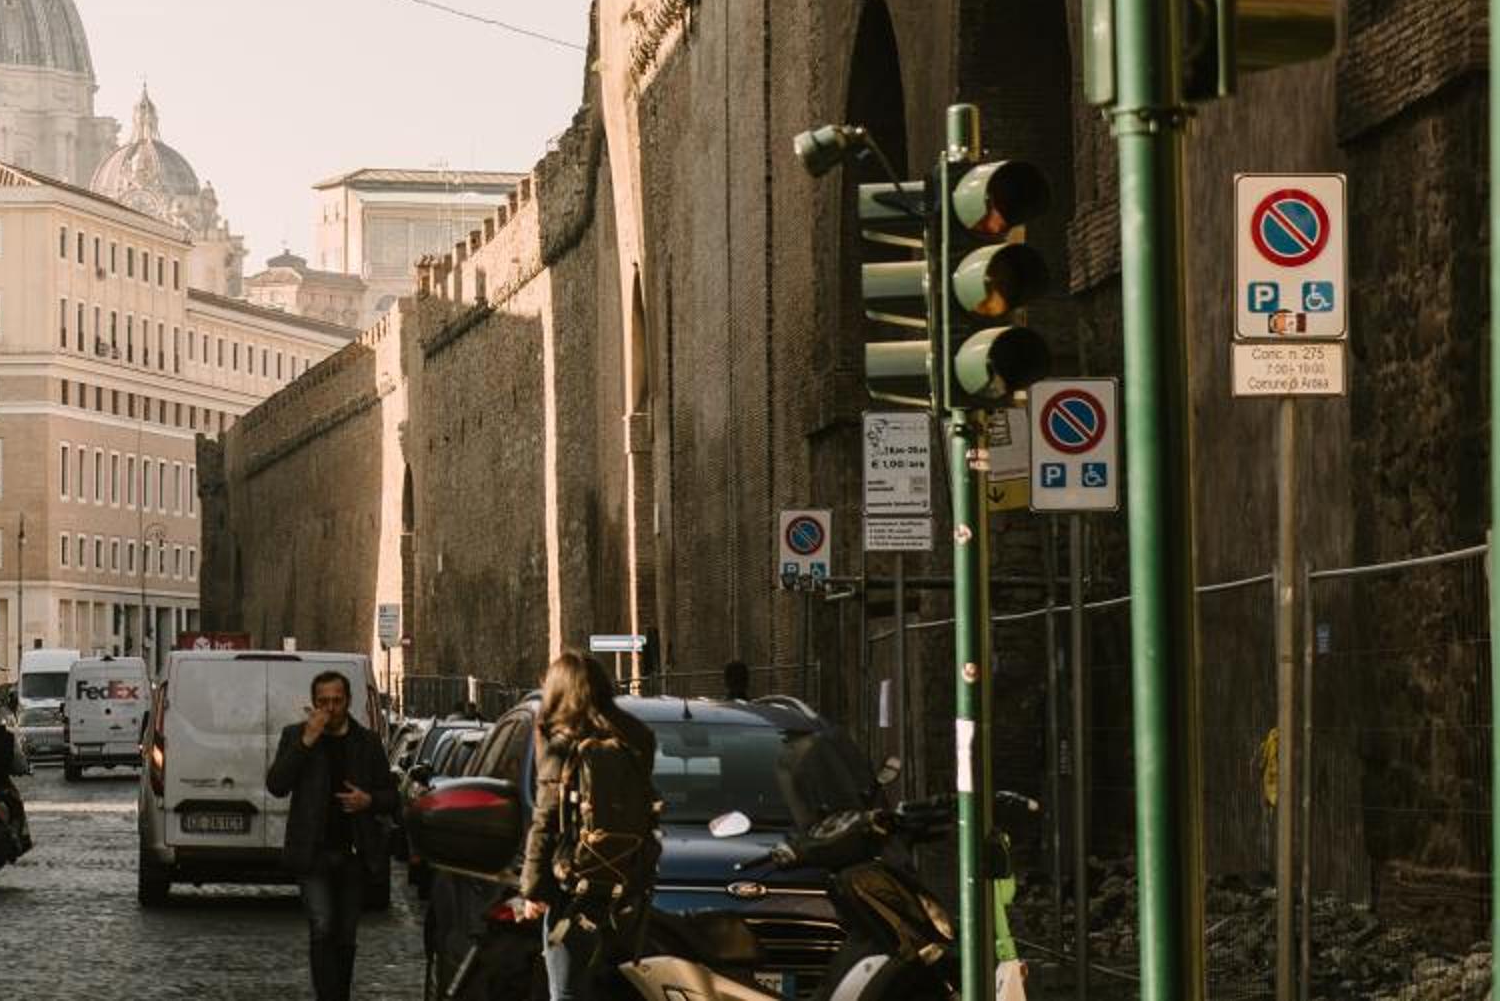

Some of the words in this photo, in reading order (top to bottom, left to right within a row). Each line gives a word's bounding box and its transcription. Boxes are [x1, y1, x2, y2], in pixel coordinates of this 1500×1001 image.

[1255, 285, 1274, 311] P
[1302, 346, 1325, 360] 275
[1045, 465, 1061, 486] P
[76, 680, 140, 700] FedEx
